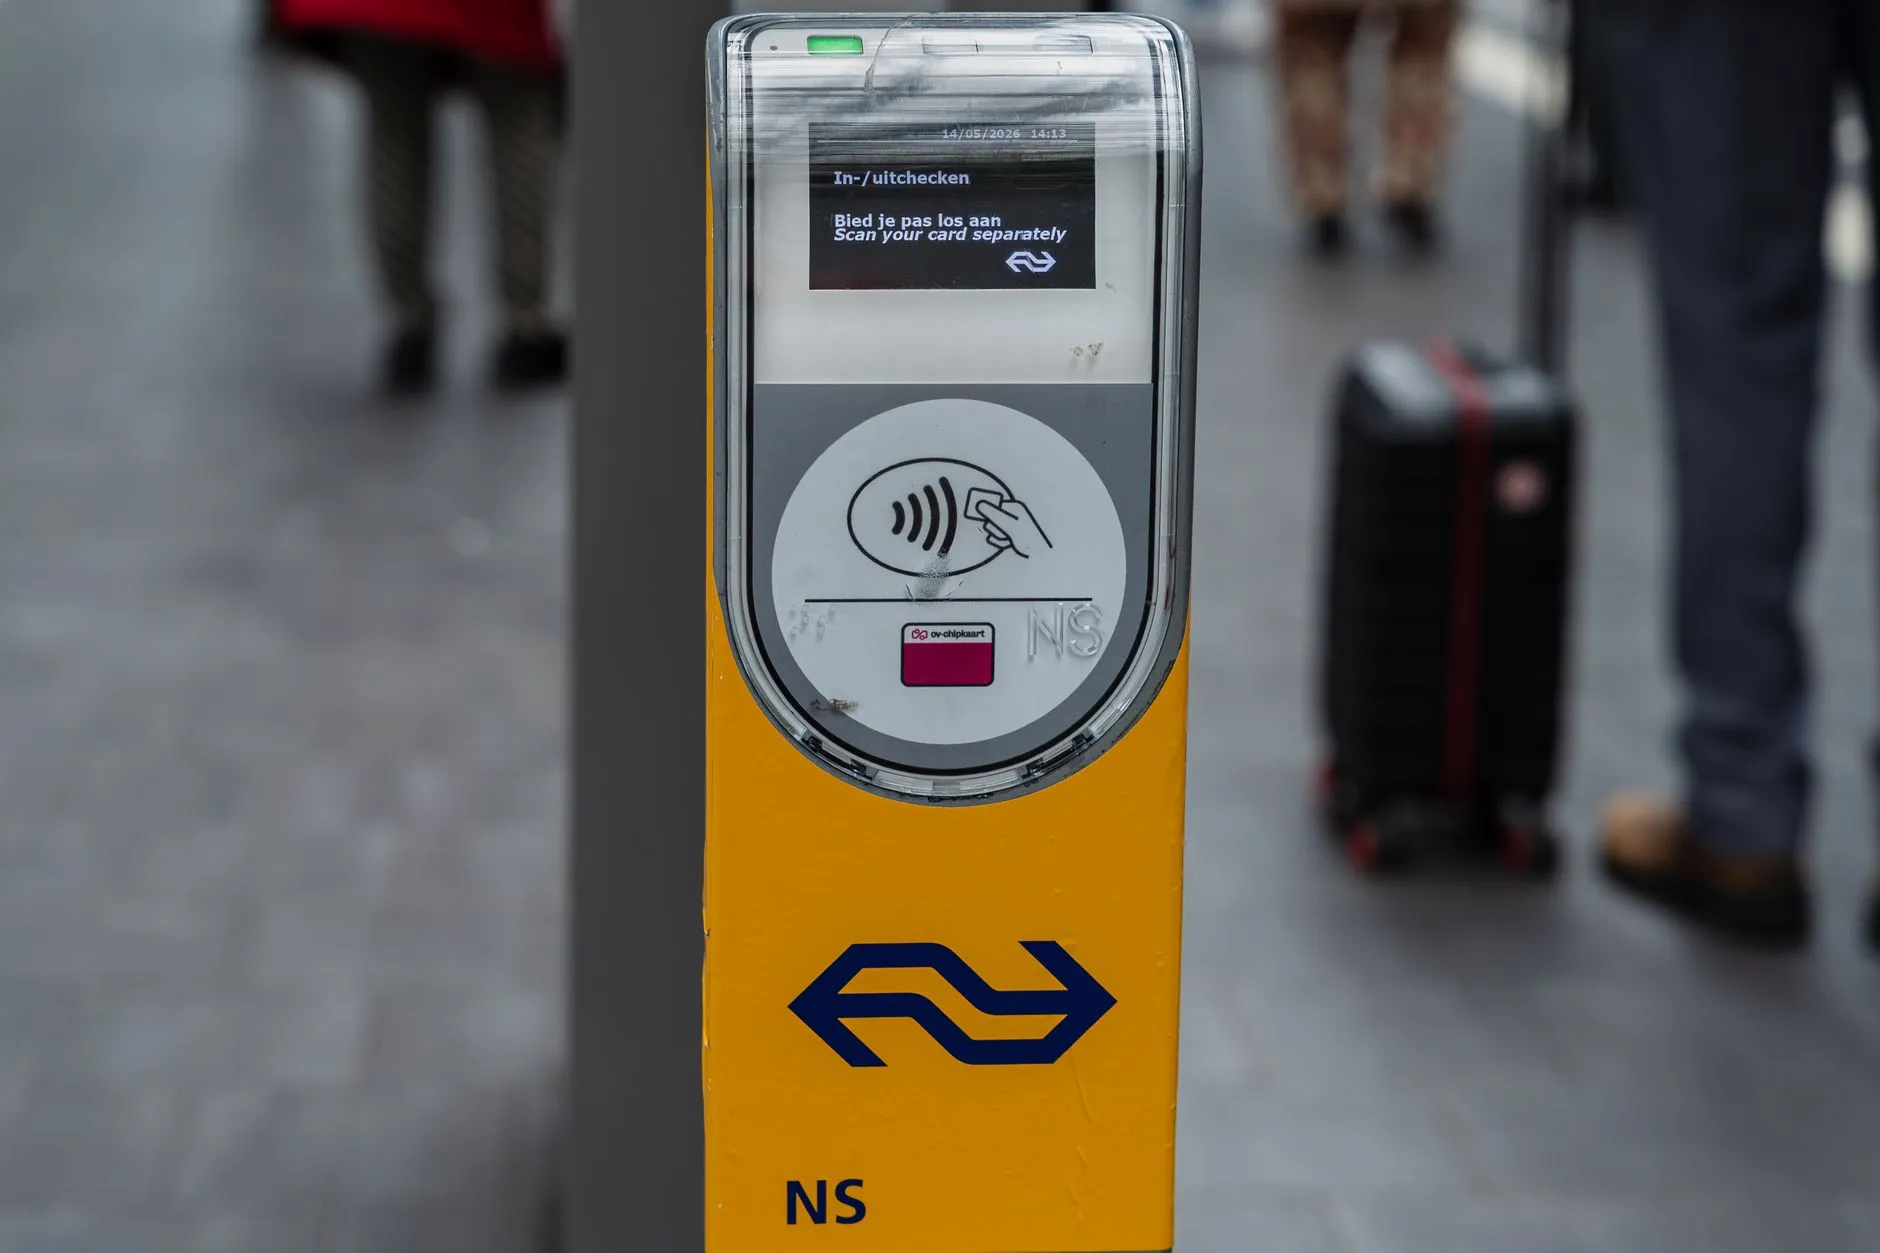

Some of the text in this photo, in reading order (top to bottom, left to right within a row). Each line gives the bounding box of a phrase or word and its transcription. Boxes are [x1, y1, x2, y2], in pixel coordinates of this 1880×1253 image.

[942, 129, 1067, 139] 14/05/2026 14:13
[834, 171, 970, 187] In-/uitchecken
[835, 214, 1002, 231] Bied je pas los aan
[834, 227, 1067, 243] Scan your card separately
[931, 628, 986, 639] ov-chipkaart
[786, 1179, 867, 1225] NS
